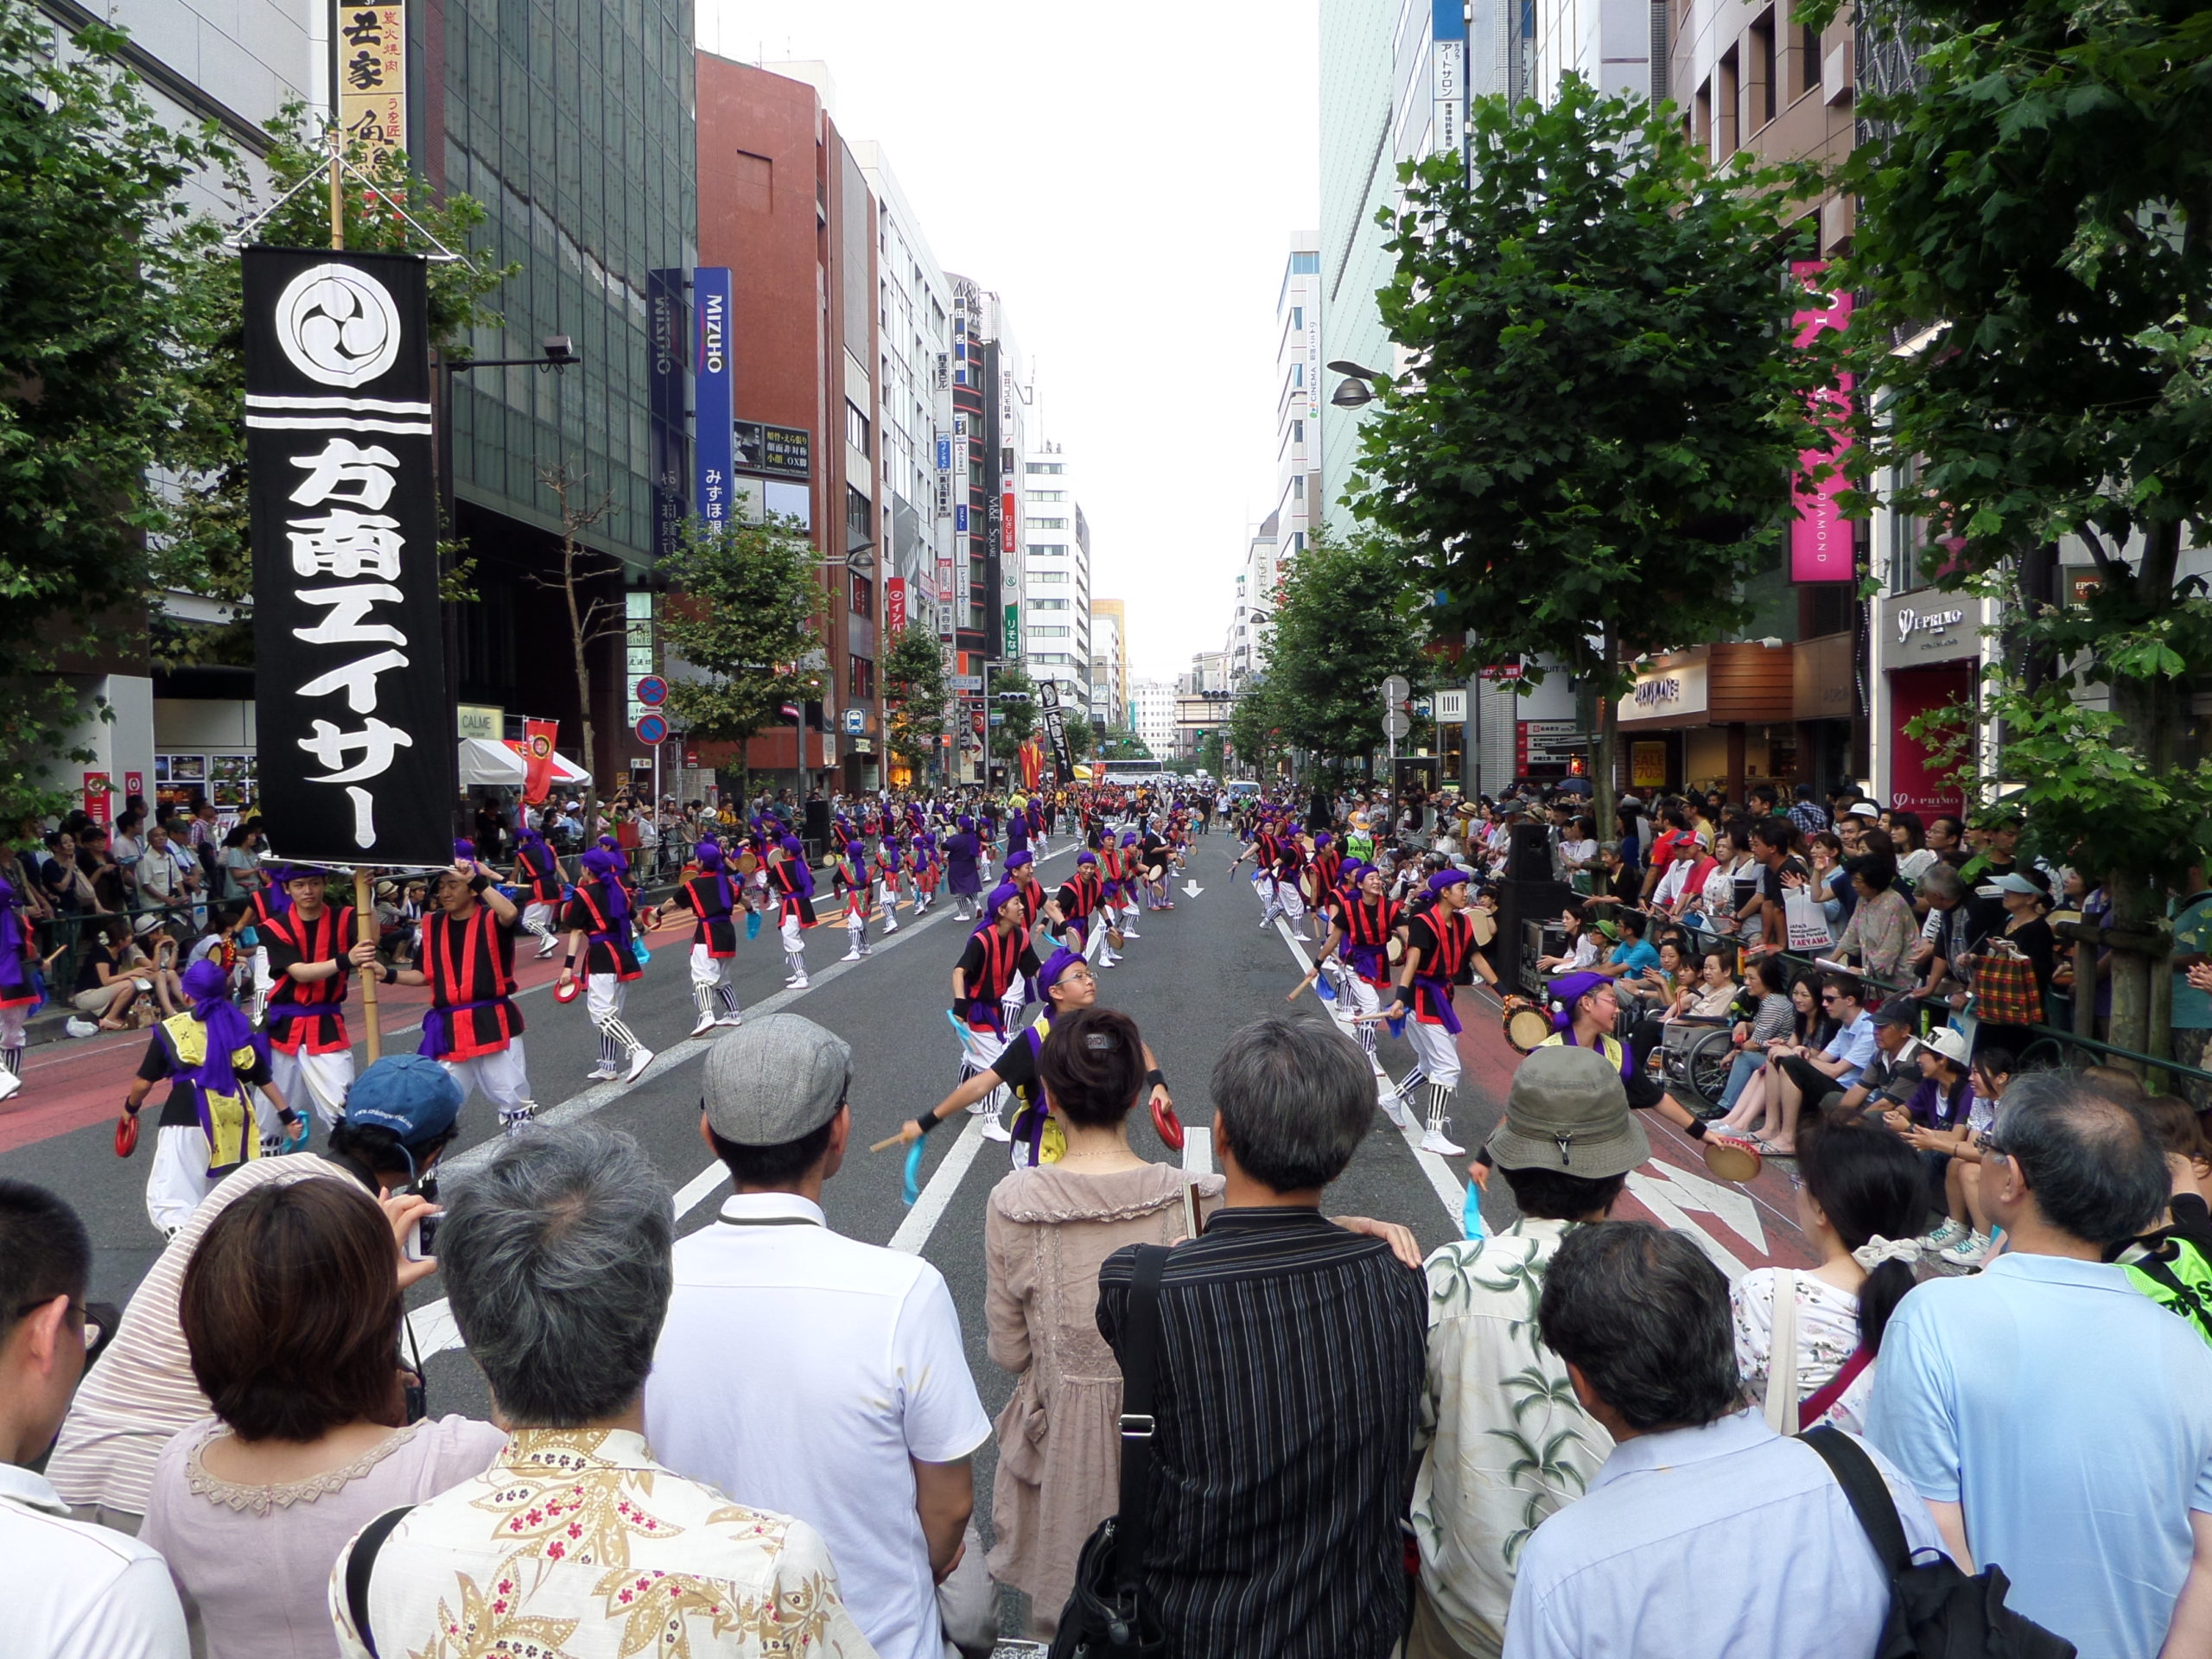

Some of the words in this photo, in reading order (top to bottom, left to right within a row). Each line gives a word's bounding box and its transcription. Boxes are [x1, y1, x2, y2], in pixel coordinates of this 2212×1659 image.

[342, 10, 383, 90] 丑家
[1441, 43, 1452, 97] アートサロン
[707, 295, 721, 373] MIZUHO
[1817, 493, 1827, 562] DIAMOND
[289, 438, 413, 849] 方南エイサー
[462, 715, 491, 729] CALME
[1790, 936, 1829, 946] YAEYAMA
